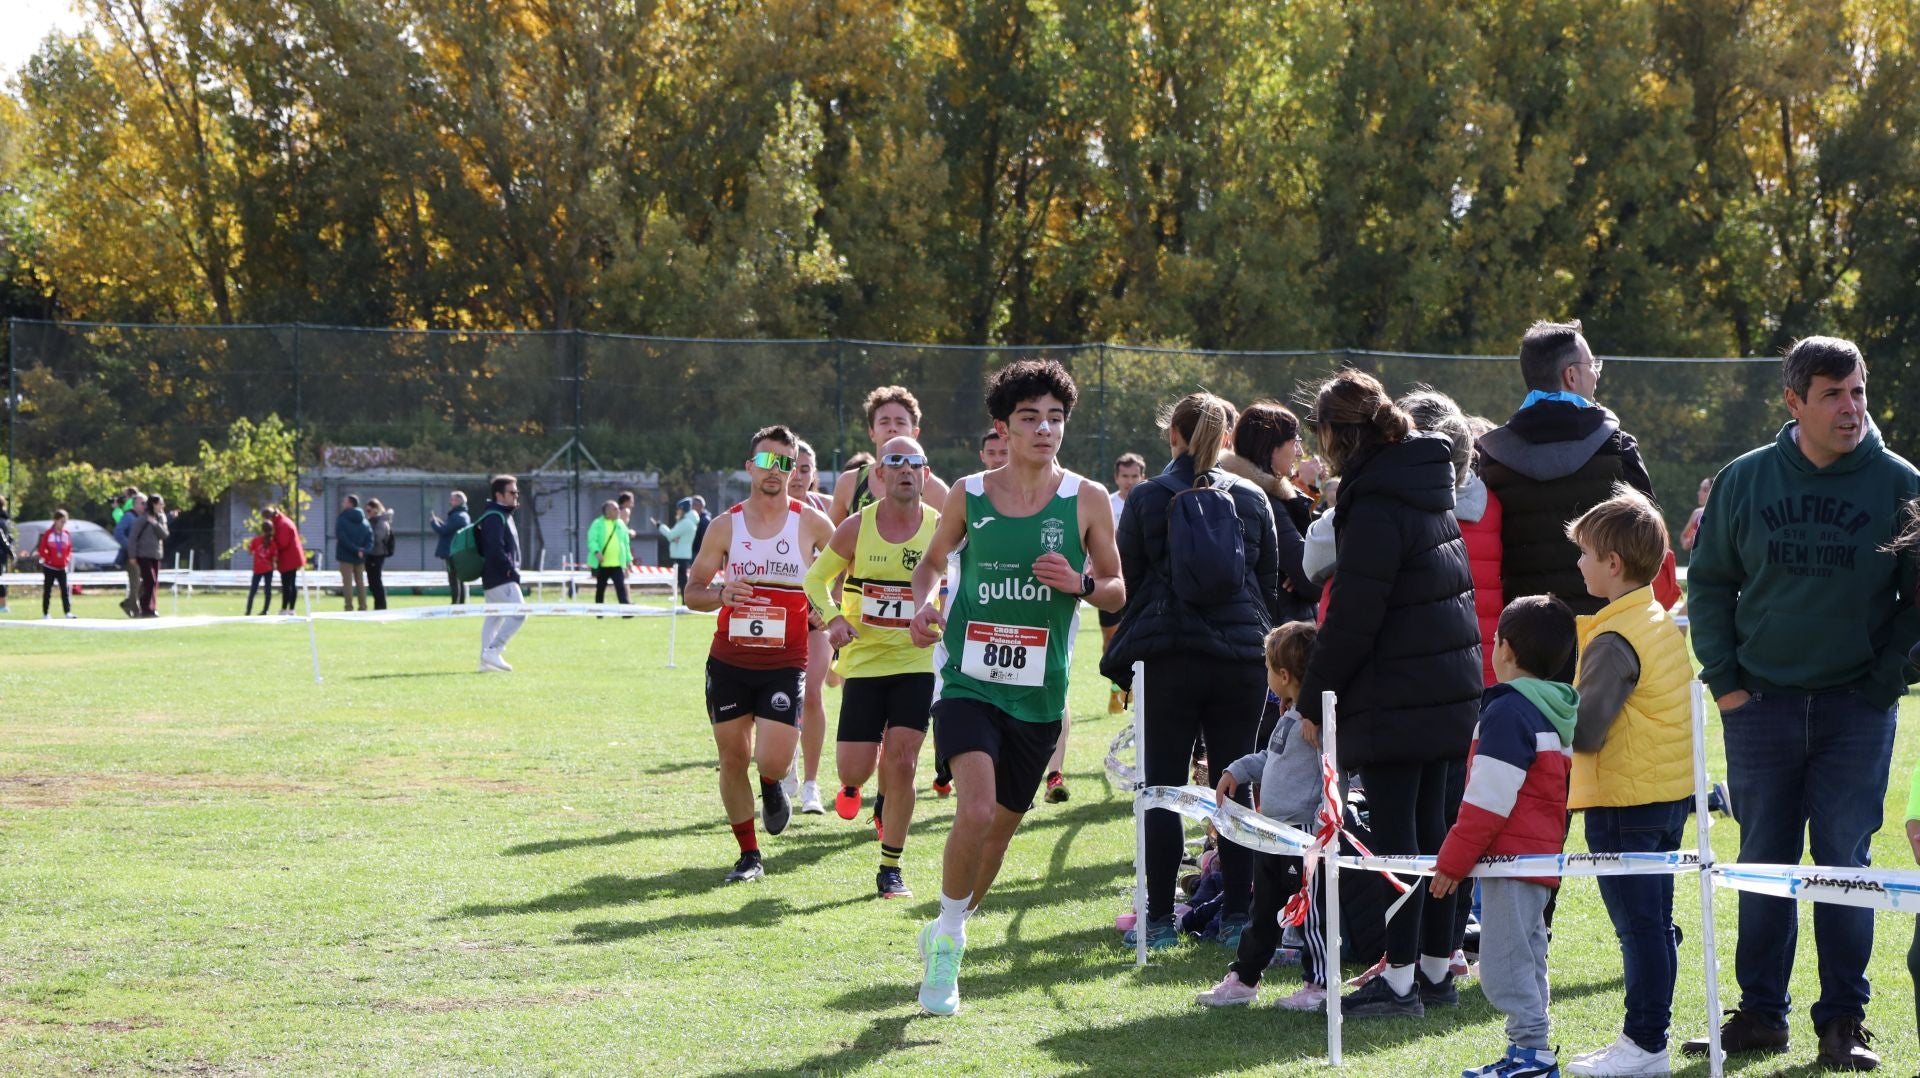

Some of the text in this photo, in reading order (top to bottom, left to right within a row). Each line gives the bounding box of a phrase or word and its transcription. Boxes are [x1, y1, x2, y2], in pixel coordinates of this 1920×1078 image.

[1760, 494, 1871, 536] HILFIGER
[1783, 529, 1806, 540] 5TH
[1767, 539, 1858, 570] NEW YORK
[978, 576, 1052, 605] gullón
[876, 599, 902, 618] 71
[749, 619, 764, 637] 6
[993, 626, 1019, 635] CROSS
[989, 636, 1022, 645] Palencia
[983, 643, 1027, 670] 808
